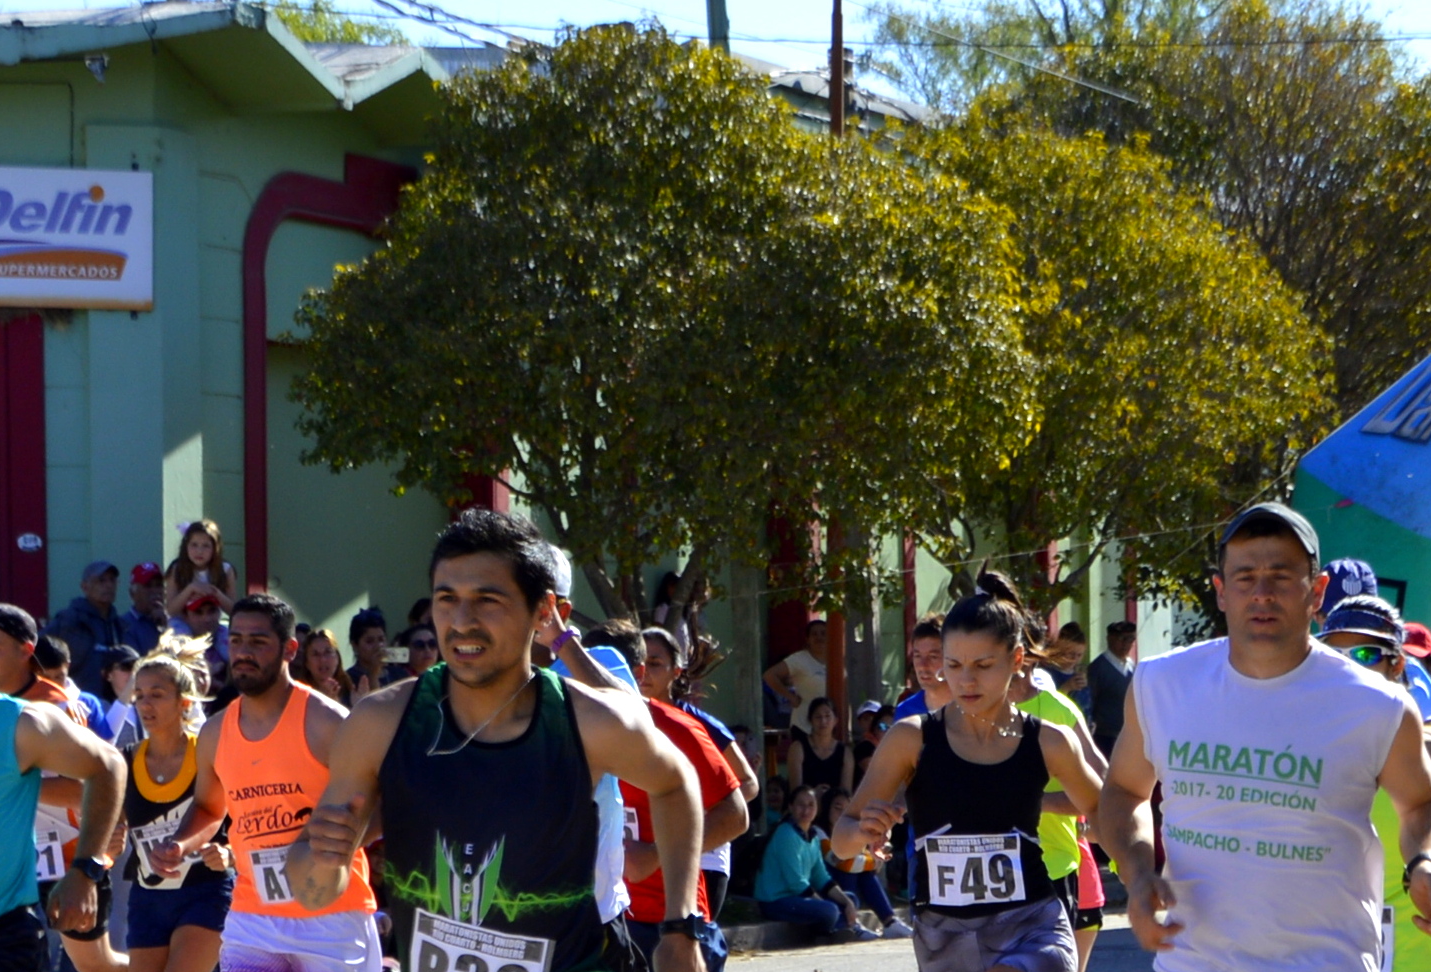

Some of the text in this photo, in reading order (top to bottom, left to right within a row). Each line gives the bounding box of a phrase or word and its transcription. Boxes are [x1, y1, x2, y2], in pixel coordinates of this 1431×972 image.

[1168, 739, 1324, 785] MARATÓN
[228, 782, 305, 802] CARNICERIA
[1216, 784, 1236, 801] 20
[1240, 787, 1317, 813] EDICIÓN
